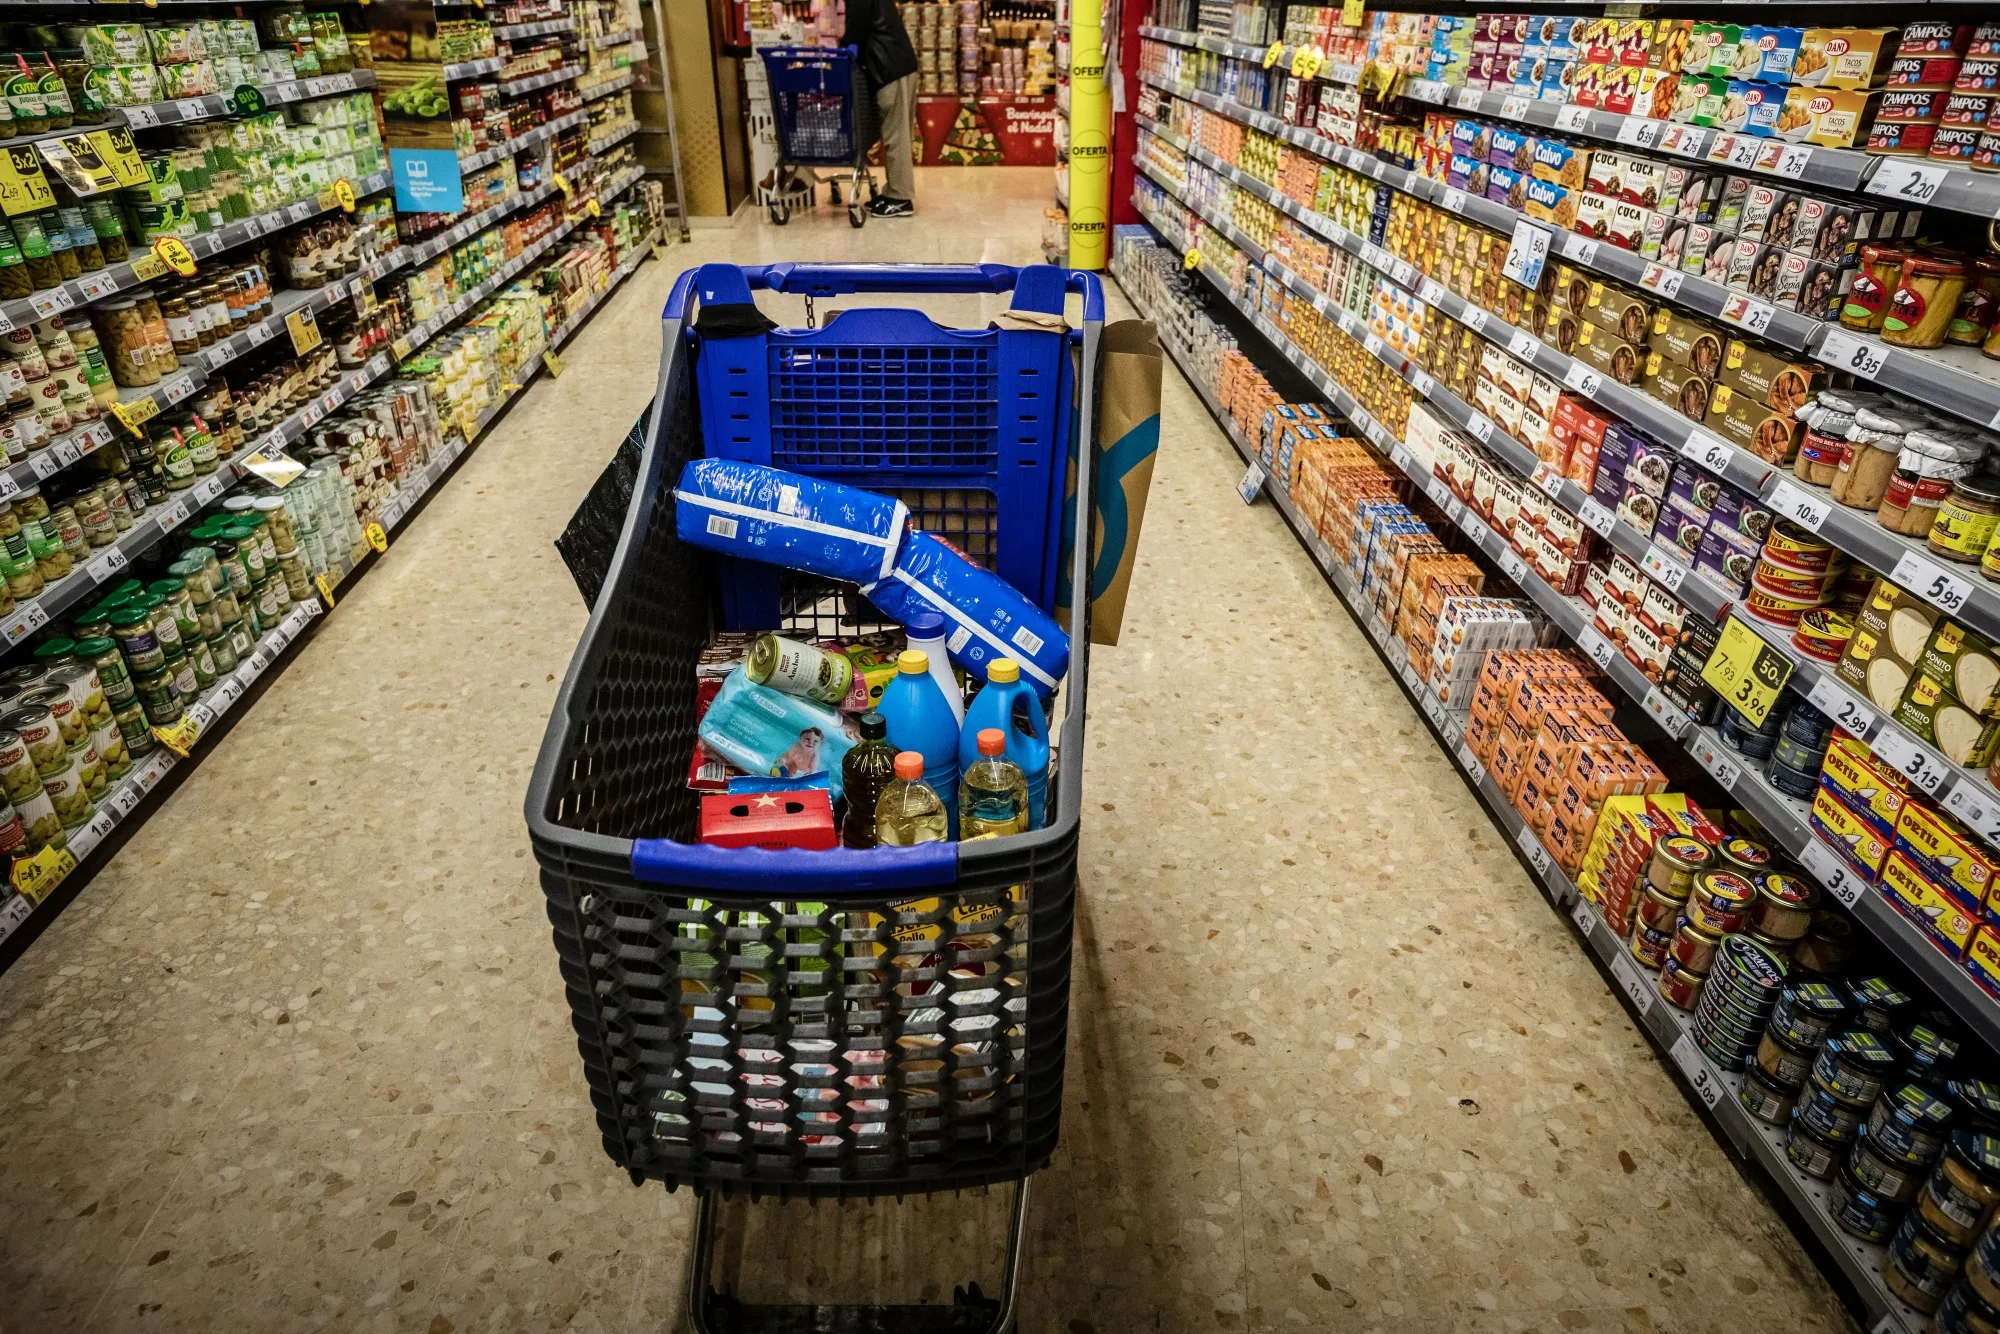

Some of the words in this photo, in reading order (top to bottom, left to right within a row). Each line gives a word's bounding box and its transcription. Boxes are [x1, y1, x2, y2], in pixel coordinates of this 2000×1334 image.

[1707, 34, 1722, 45] DANI
[1903, 25, 1952, 41] CAMPOS
[1758, 37, 1776, 51] DANI
[1826, 40, 1848, 53] DANI
[1718, 49, 1732, 59] TACOS
[1770, 53, 1788, 64] TACOS
[1844, 58, 1863, 68] TACOS
[237, 90, 258, 104] BIO
[1745, 92, 1761, 104] DANI
[1882, 92, 1931, 107] CAMPOS
[1948, 96, 1988, 111] CAMPOS
[1755, 107, 1773, 118] TACOS
[1810, 99, 1830, 112] DANI
[1007, 121, 1019, 134] el
[1020, 122, 1054, 134] Nadal
[1827, 116, 1846, 126] TACOS
[1453, 123, 1474, 141] Calvo
[1934, 129, 1976, 145] CAMPOS
[66, 142, 93, 157] 3x2
[113, 134, 131, 150] 3x2
[1492, 133, 1517, 152] Calvo
[1072, 146, 1108, 156] OFERTA
[1535, 144, 1562, 165] Calvo
[12, 152, 36, 170] 3x2
[1451, 159, 1472, 175] Calvo
[1595, 152, 1618, 167] CUCA
[1629, 161, 1655, 177] CUCA
[1490, 169, 1512, 189] Calvo
[1730, 180, 1747, 192] DANI
[1528, 181, 1556, 203] Calvo
[1753, 191, 1769, 203] DANI
[1582, 195, 1605, 210] CUCA
[1804, 204, 1820, 216] DANI
[1617, 207, 1641, 221] CUCA
[1743, 206, 1768, 223] Sepia
[1071, 222, 1106, 232] OFERTA
[1794, 220, 1817, 237] Sepia
[1740, 242, 1754, 255] DANI
[1731, 258, 1752, 273] Sepia
[1788, 259, 1804, 273] DANI
[1776, 274, 1801, 291] Sepia
[1484, 345, 1500, 360] CUCA
[1506, 359, 1525, 377] CUCA
[1477, 376, 1493, 395] CUCA
[1534, 375, 1551, 393] CUCA
[1499, 393, 1515, 412] CUCA
[1524, 410, 1541, 430] CUCA
[1438, 433, 1455, 451] CUCA
[1457, 448, 1473, 466] CUCA
[1705, 446, 1727, 470] 6,49
[1476, 465, 1492, 485] CUCA
[1497, 483, 1515, 503] CUCA
[1862, 609, 1887, 630] BONITO
[1841, 658, 1865, 679] BONITO
[1925, 649, 1952, 672] BONITO
[1902, 701, 1930, 725] BONITO
[1827, 753, 1860, 785] ORTIZ
[1816, 795, 1846, 828] ORTIZ
[1860, 804, 1880, 822] NORTE
[90, 818, 112, 838] 1,89
[1902, 814, 1939, 850] ORTIZ
[1908, 846, 1931, 866] BONITO
[1941, 872, 1962, 893] NORTE
[1887, 864, 1923, 900] ORTIZ
[1694, 1069, 1717, 1104] 3,09
